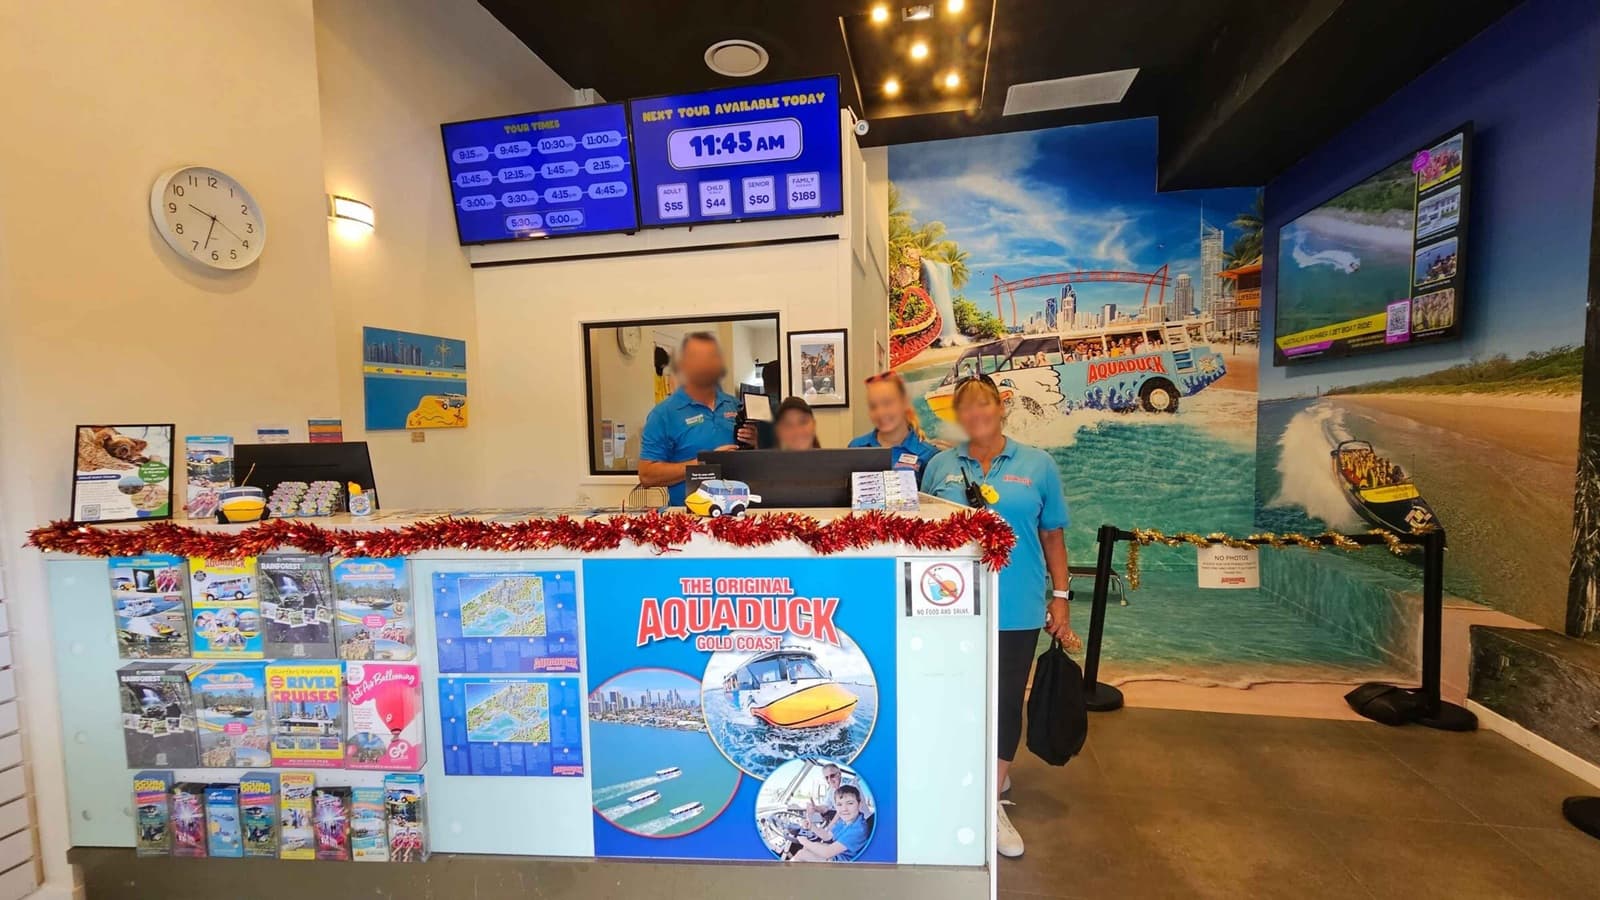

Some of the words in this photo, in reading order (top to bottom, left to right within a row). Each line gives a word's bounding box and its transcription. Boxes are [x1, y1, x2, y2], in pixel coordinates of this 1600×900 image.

[642, 110, 673, 122] NEXT
[678, 105, 710, 118] TOUR
[715, 96, 780, 114] AVAILABLE
[781, 92, 826, 107] TODAY
[504, 122, 530, 134] TOUR
[531, 120, 560, 132] TIMES
[689, 131, 753, 157] 11:45
[756, 135, 785, 151] AM
[189, 175, 197, 187] 11
[208, 176, 218, 188] 12
[792, 177, 815, 185] FAMILY
[173, 184, 184, 197] 10
[230, 188, 233, 198] 1
[749, 195, 770, 205] $50
[792, 191, 816, 202] $169
[168, 202, 177, 213] 9
[664, 201, 683, 211] $55
[706, 198, 726, 208] $44
[241, 204, 248, 215] 2
[176, 223, 184, 234] 8
[246, 223, 254, 233] 3
[192, 240, 199, 251] 7
[242, 240, 249, 250] 4
[211, 250, 219, 261] 6
[230, 249, 237, 260] 5
[1087, 355, 1169, 386] AQUADUCK
[680, 577, 713, 594] THE
[716, 577, 793, 595] ORIGINAL
[926, 608, 940, 616] FOOD
[637, 597, 841, 647] AQUADUCK
[697, 636, 734, 651] GOLD
[737, 635, 782, 651] COAST
[286, 676, 337, 688] RIVER
[372, 669, 415, 685] Ballooning
[271, 690, 339, 703] CRUISES
